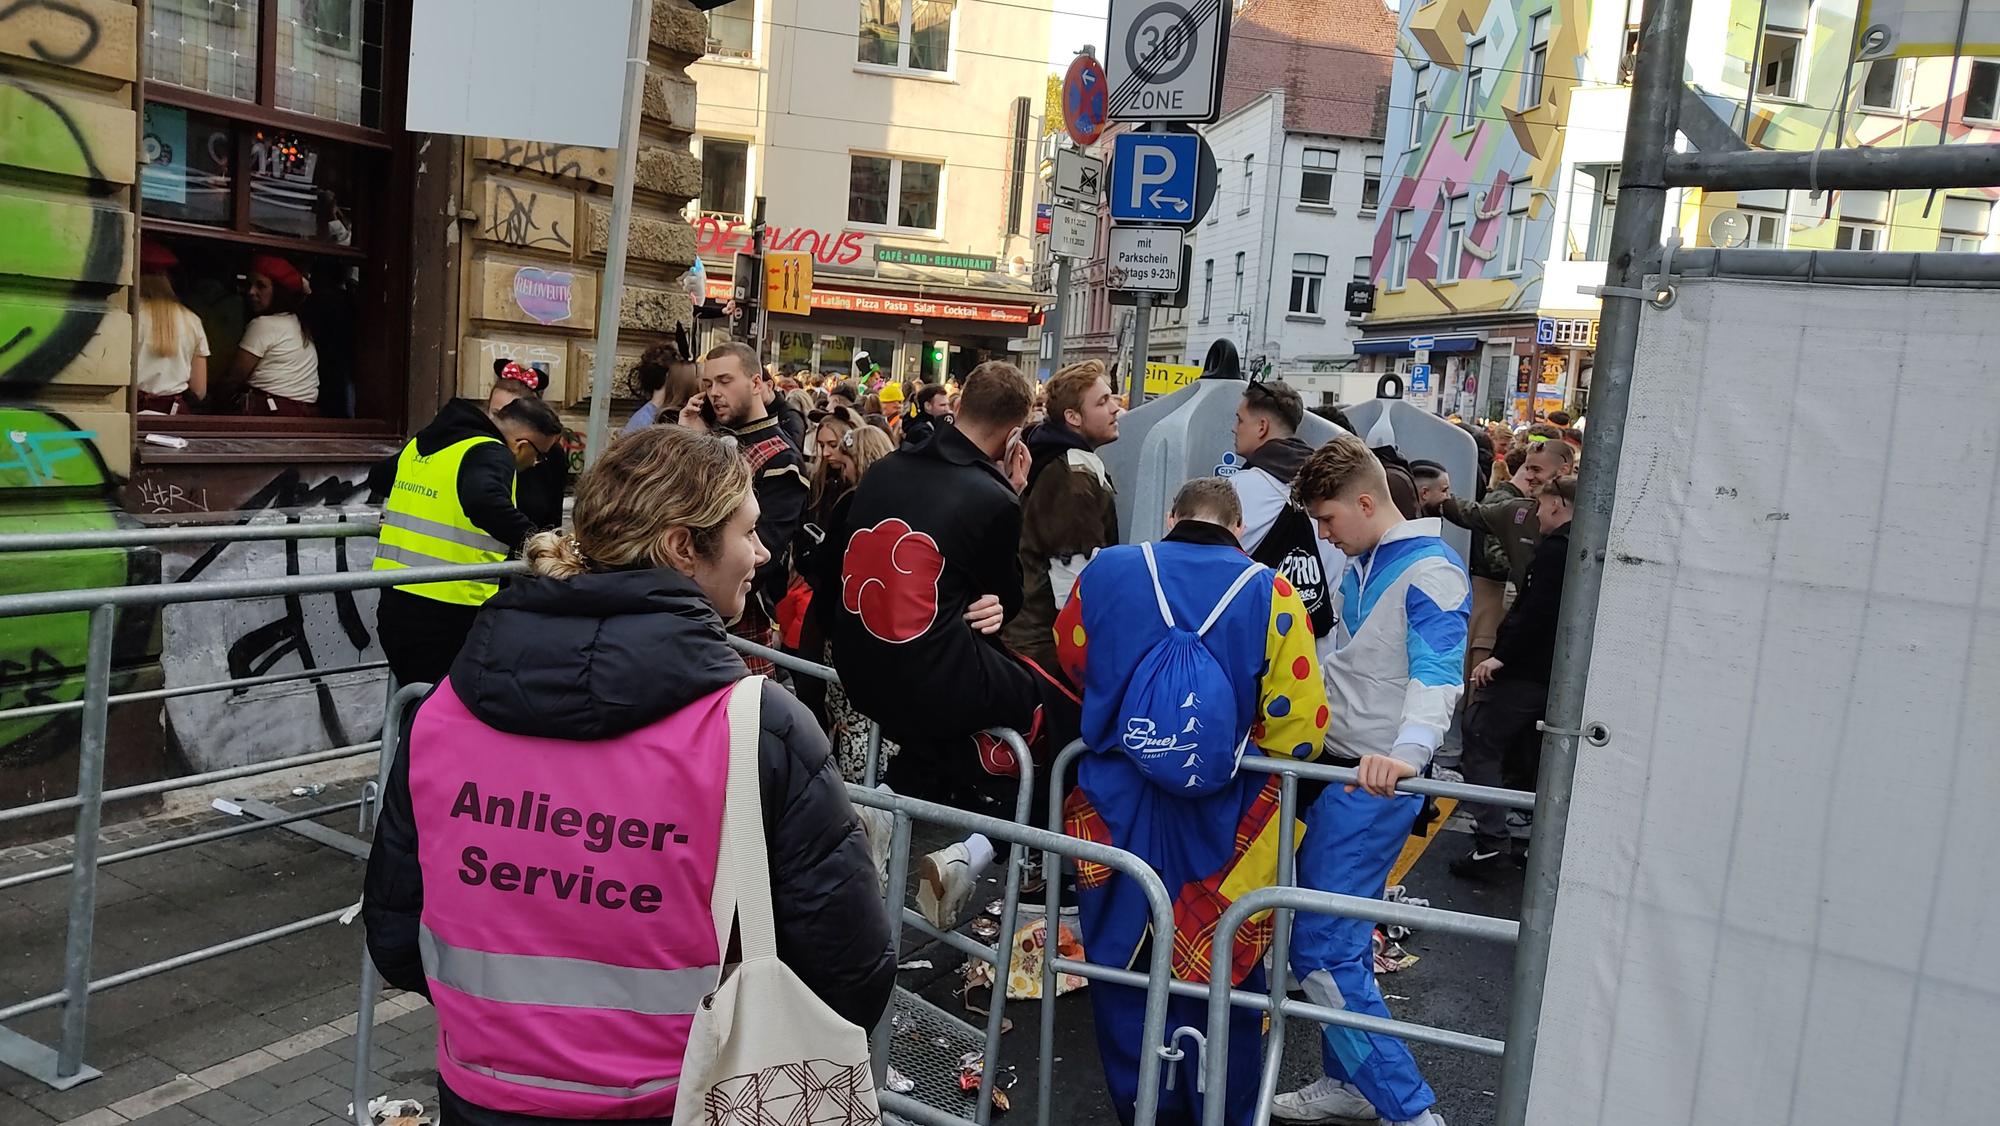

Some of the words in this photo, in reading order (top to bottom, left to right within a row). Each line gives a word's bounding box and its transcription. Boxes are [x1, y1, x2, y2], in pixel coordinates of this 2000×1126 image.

[1139, 24, 1183, 62] 30
[1129, 90, 1184, 110] ZONE
[1130, 144, 1177, 209] P
[1137, 237, 1152, 248] mit
[879, 250, 902, 262] CAFÉ
[909, 252, 928, 264] BAR
[934, 255, 993, 270] RESTAURANT
[1118, 251, 1168, 265] Parkschein
[1150, 267, 1176, 280] 9-23h
[855, 299, 880, 309] Pizza
[884, 300, 908, 311] Pasta
[913, 302, 936, 313] Salat
[943, 304, 978, 317] Cocktail
[449, 780, 689, 853] Anlieger-
[458, 845, 663, 914] Service
